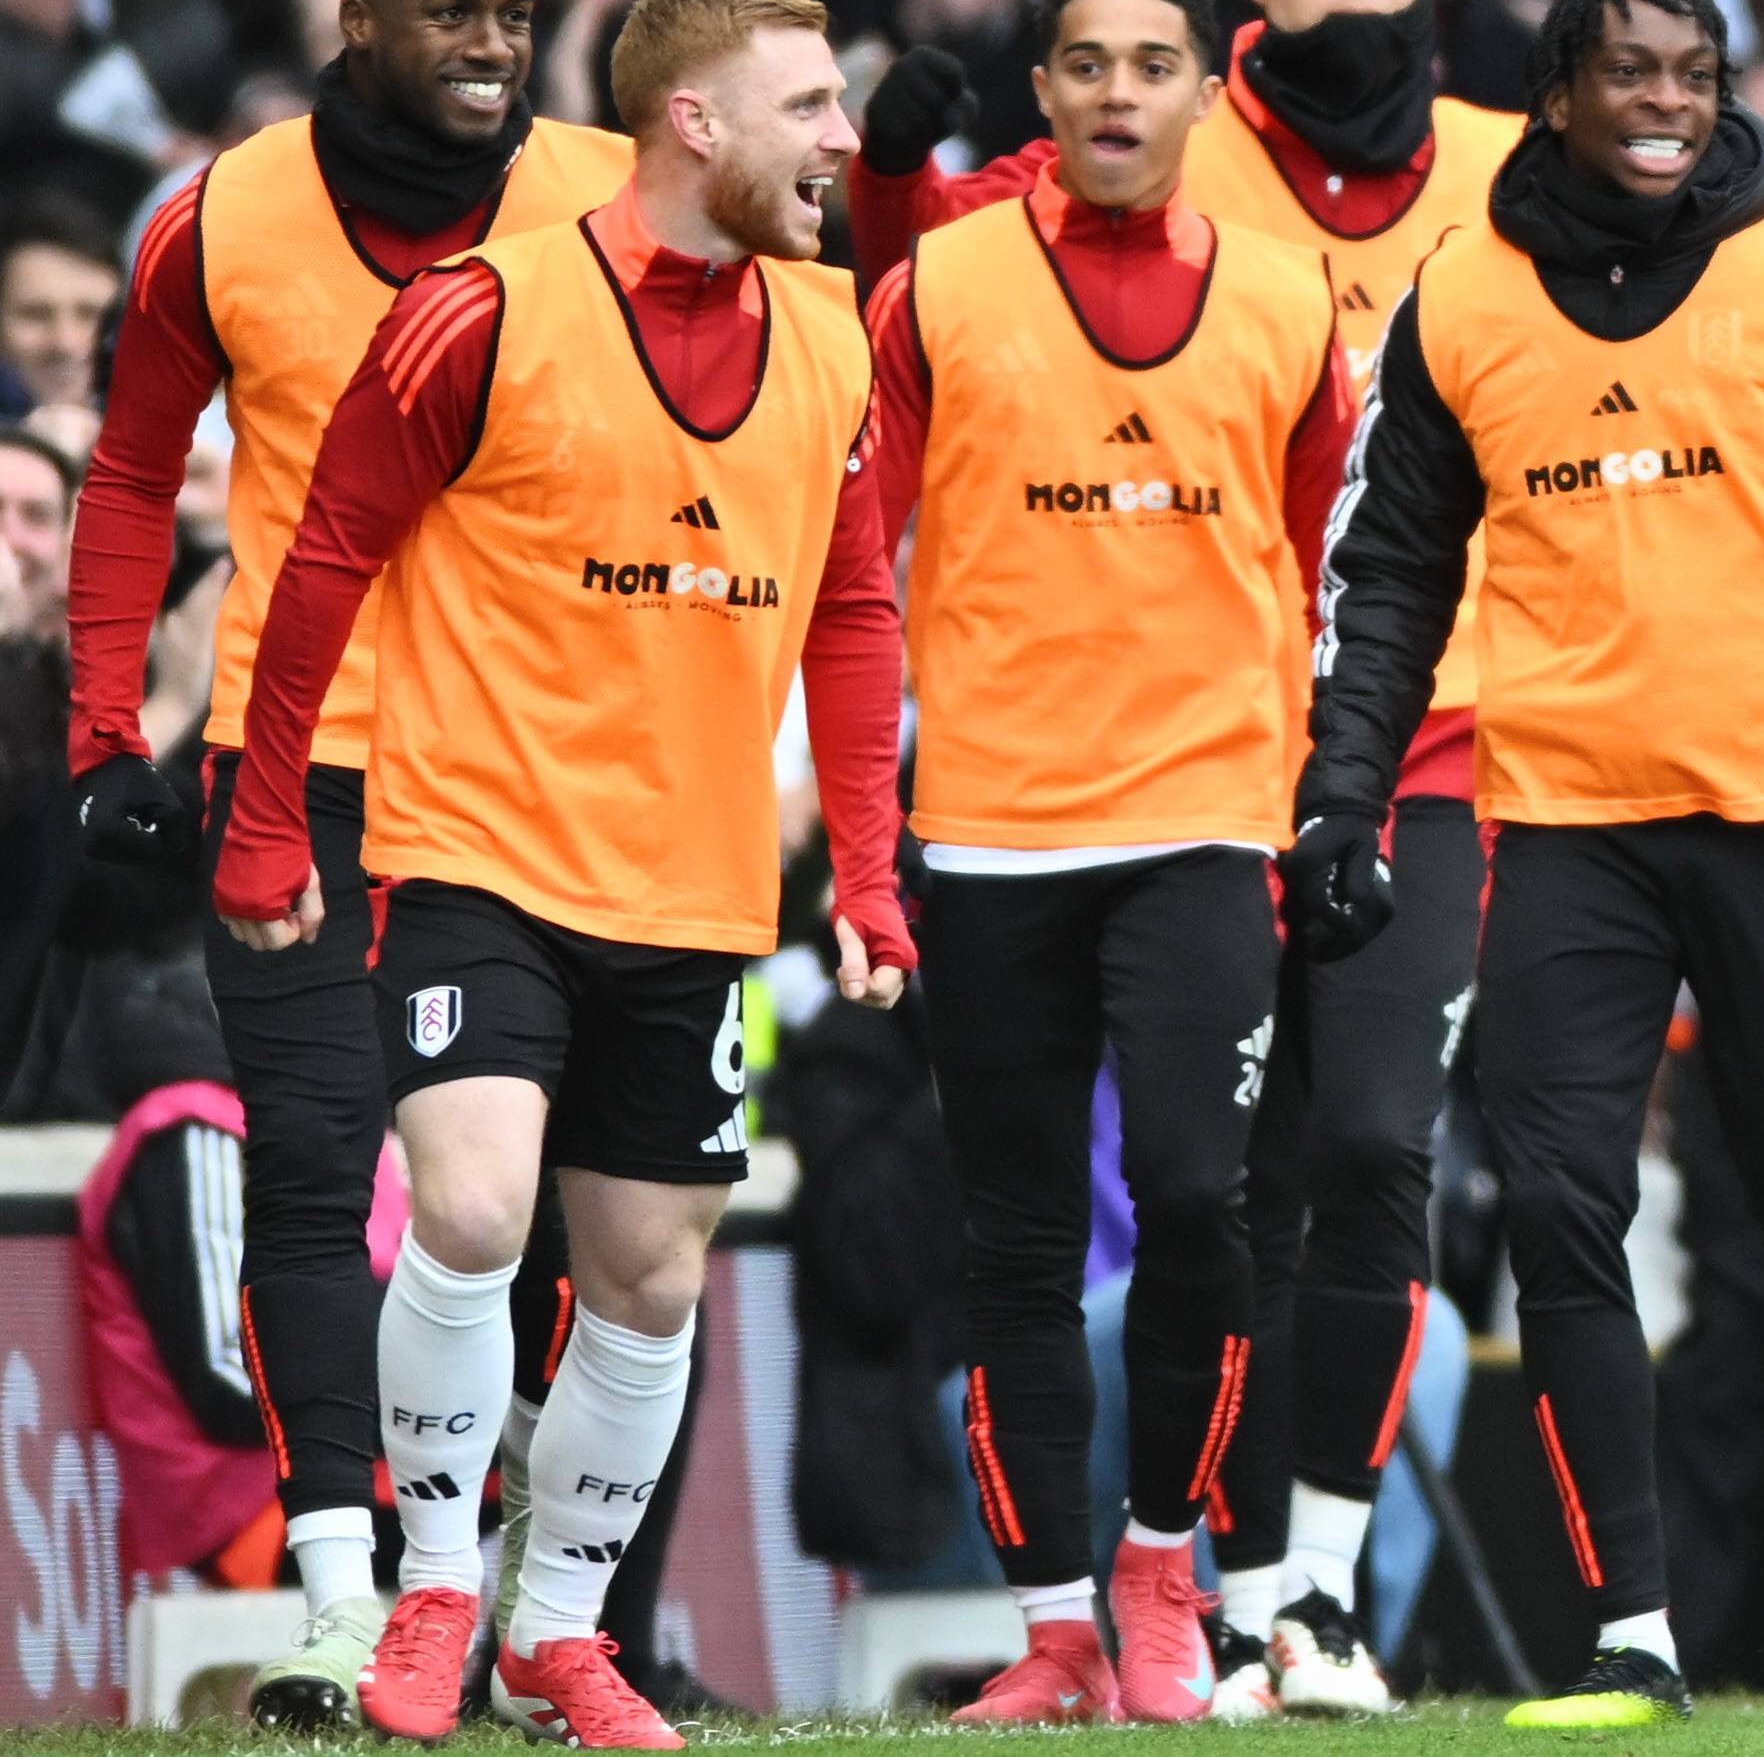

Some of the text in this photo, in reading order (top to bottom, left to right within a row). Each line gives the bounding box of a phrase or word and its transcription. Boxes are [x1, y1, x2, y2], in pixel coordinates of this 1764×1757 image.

[1525, 446, 1724, 497] MONGOLIA
[1025, 480, 1221, 516] MONGOLIA
[581, 557, 780, 608] MONGOLIA
[710, 980, 746, 1095] 6
[393, 1406, 476, 1436] FFC
[575, 1473, 657, 1504] FFC
